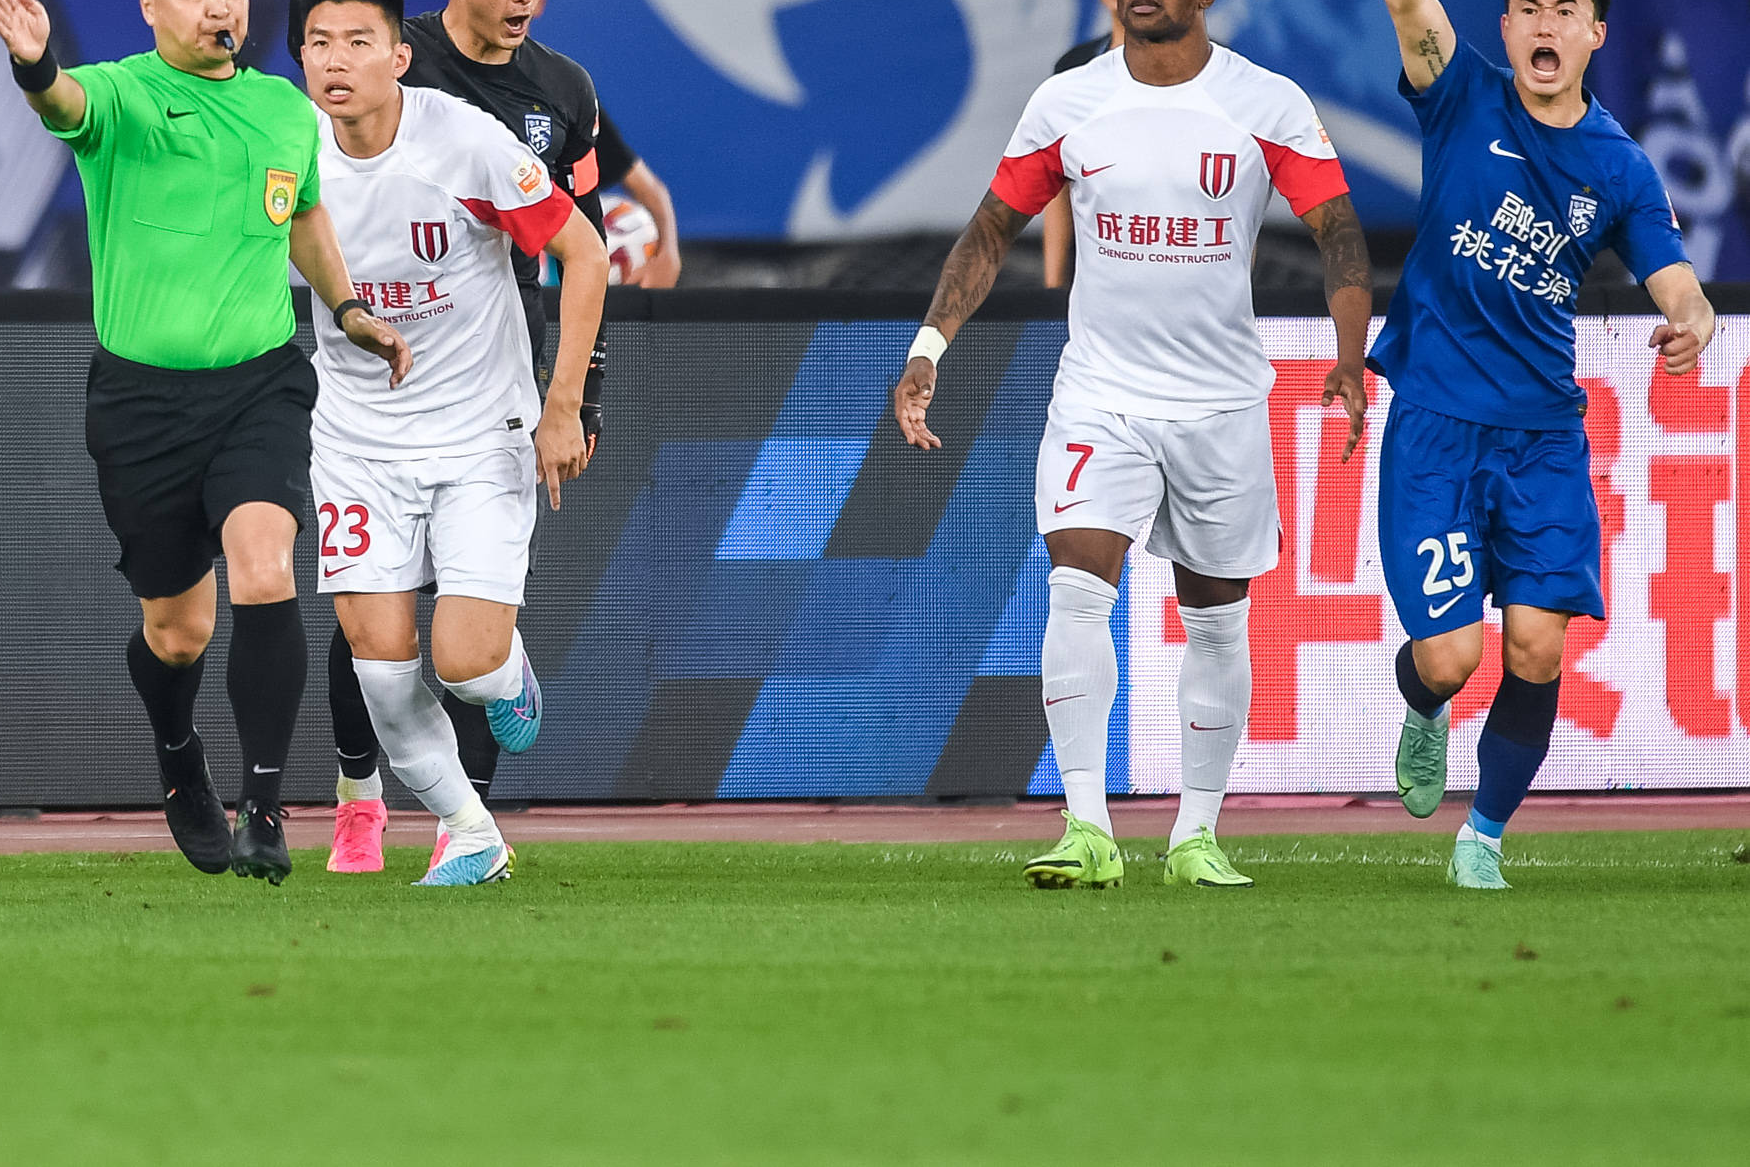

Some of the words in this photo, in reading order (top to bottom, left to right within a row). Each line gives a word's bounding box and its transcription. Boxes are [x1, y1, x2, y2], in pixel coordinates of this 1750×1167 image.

[1096, 212, 1233, 247] 成都建工
[1098, 246, 1145, 261] CHENGDU
[1148, 252, 1232, 264] CONSTRUCTION
[1490, 191, 1571, 265] 融创
[1450, 219, 1572, 305] 桃花源
[1066, 443, 1094, 491] 7
[319, 502, 371, 557] 23
[1417, 531, 1474, 596] 25
